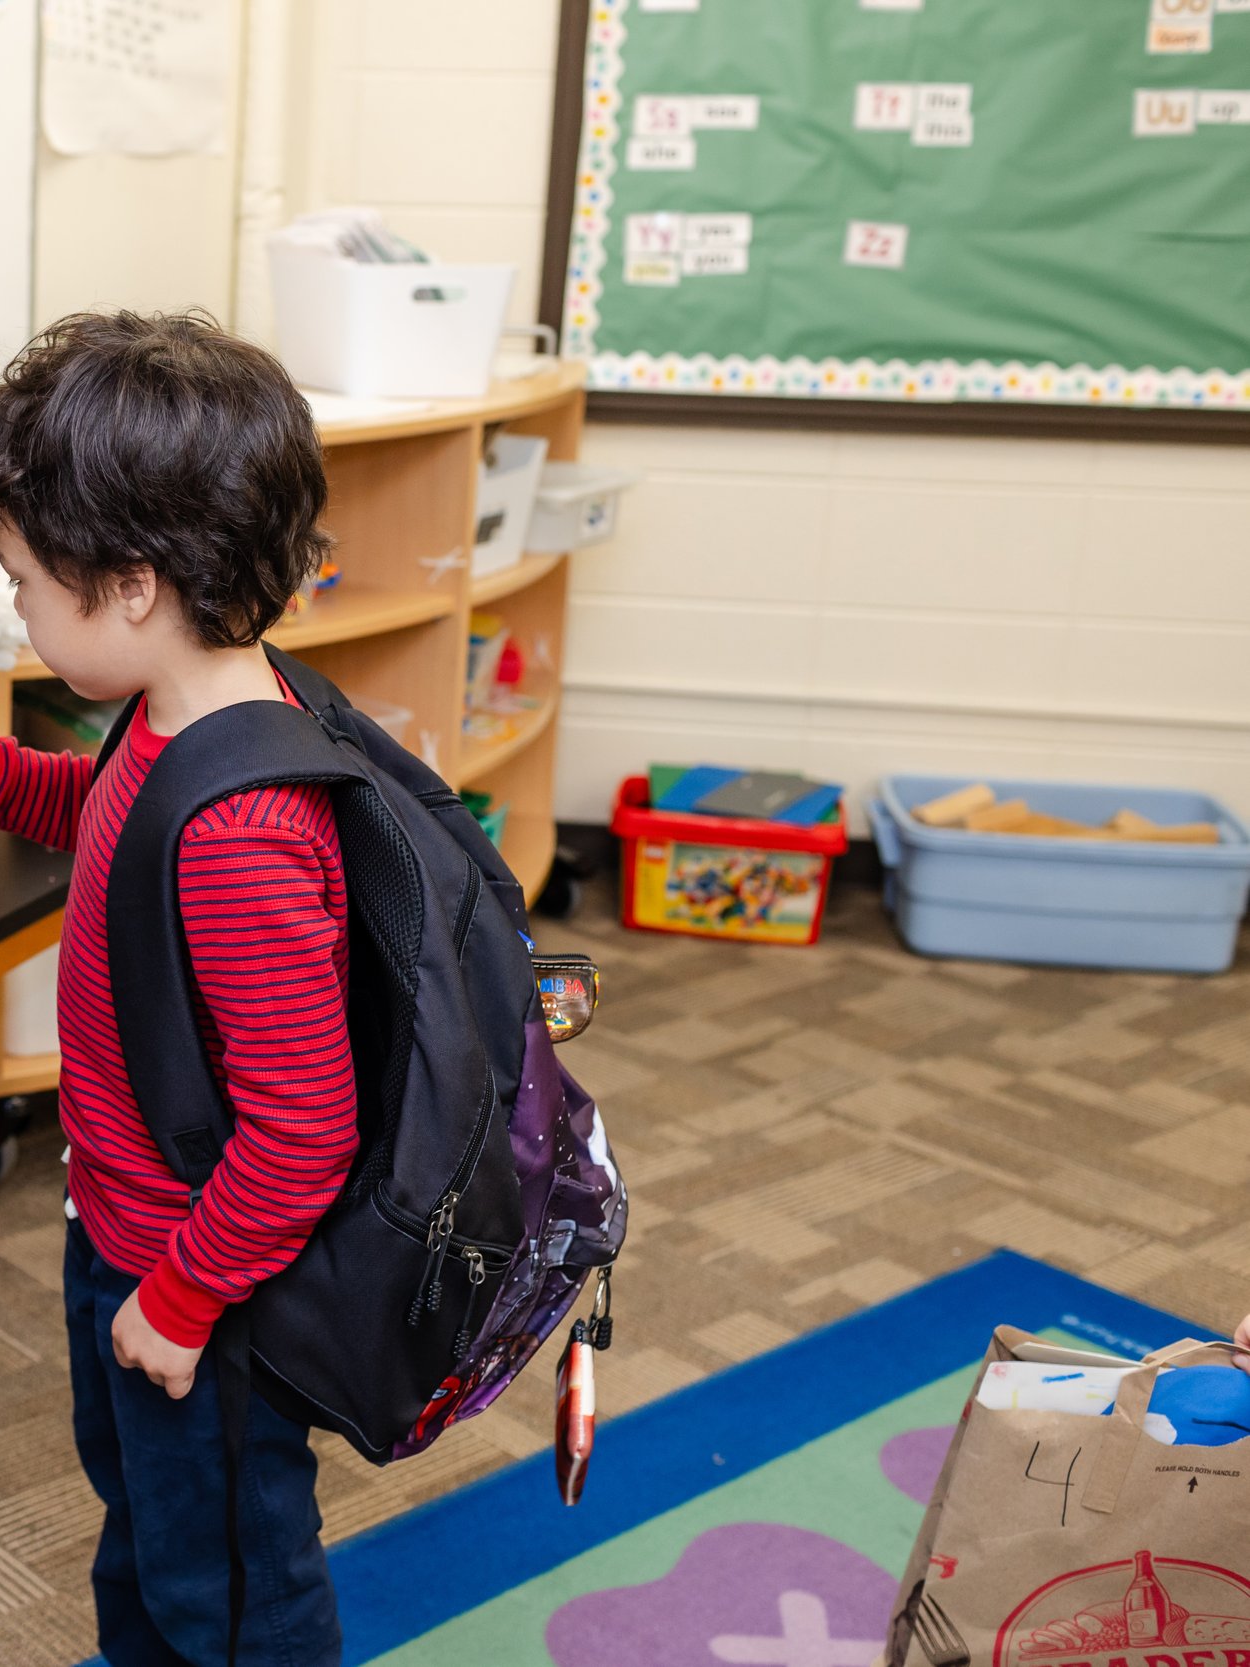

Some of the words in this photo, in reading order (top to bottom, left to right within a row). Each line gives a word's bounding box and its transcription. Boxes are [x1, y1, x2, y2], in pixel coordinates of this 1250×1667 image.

[1144, 98, 1187, 125] Uu
[536, 977, 586, 994] MBiA
[1155, 1465, 1176, 1473] PLEASE
[1178, 1465, 1193, 1473] HOLD
[1194, 1466, 1212, 1475] BOTH
[1212, 1469, 1241, 1477] HANDLES
[1023, 1440, 1083, 1528] 4
